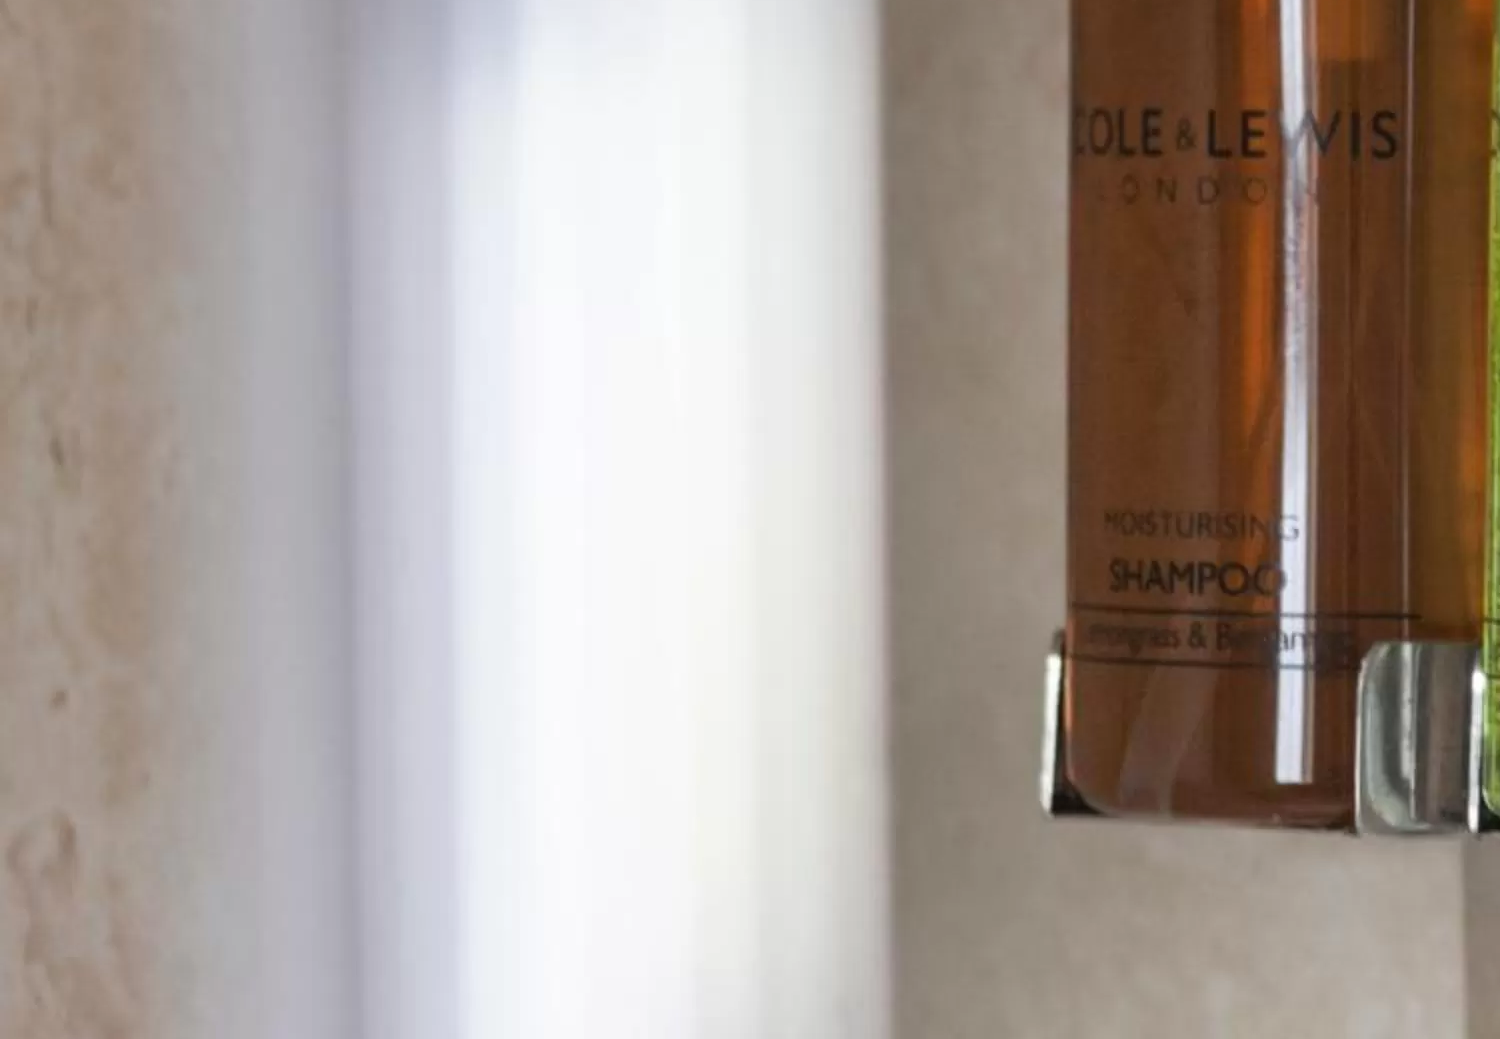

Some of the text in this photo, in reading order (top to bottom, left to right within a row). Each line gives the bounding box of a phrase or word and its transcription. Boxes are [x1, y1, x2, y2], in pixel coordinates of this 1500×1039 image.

[1175, 118, 1197, 152] &
[1207, 108, 1398, 160] LEWIS
[1103, 508, 1300, 543] MOISTURISING
[1109, 557, 1290, 597] SHAMPOO
